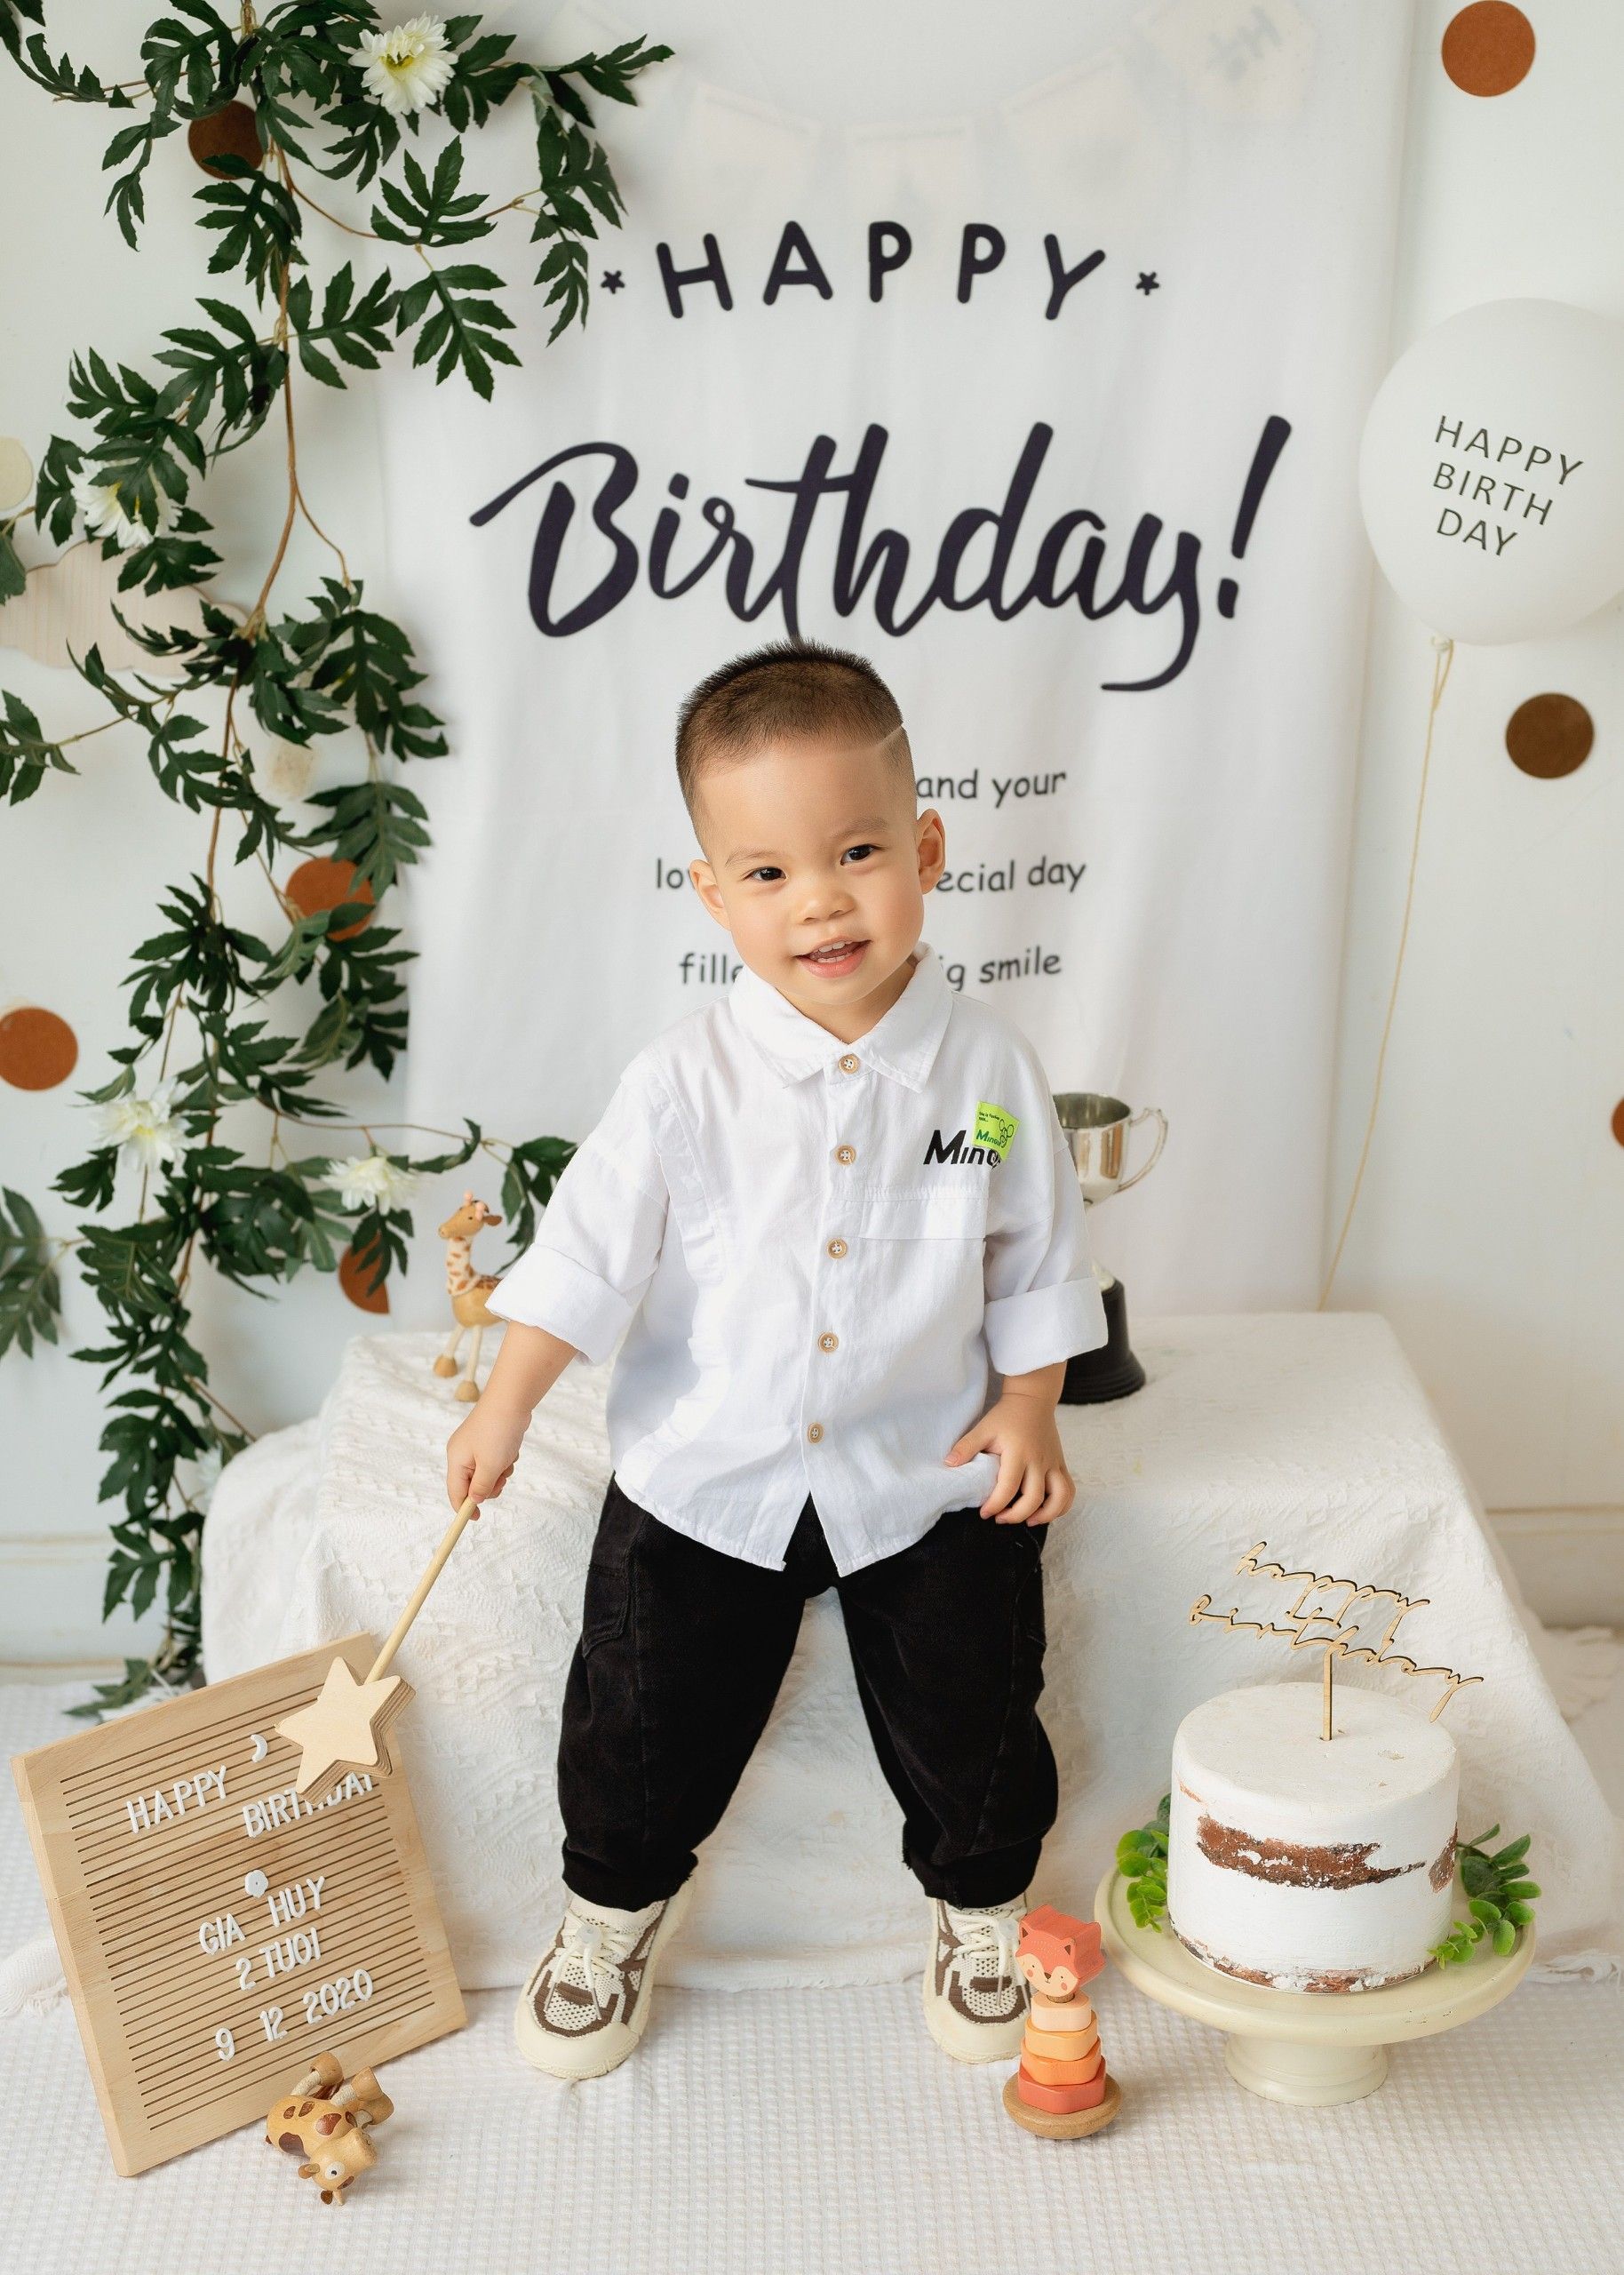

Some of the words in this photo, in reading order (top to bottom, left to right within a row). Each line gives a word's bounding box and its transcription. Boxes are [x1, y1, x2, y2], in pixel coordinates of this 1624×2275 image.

[656, 220, 1106, 321] HAPPY
[1435, 415, 1584, 486] HAPPY
[1433, 462, 1554, 526] BIRTH
[469, 414, 1292, 692] Birthday!
[1437, 507, 1517, 556] DAY
[917, 770, 978, 800] and
[992, 771, 1067, 809] your
[656, 858, 693, 890] lo
[935, 858, 1015, 893] ecial
[1028, 855, 1086, 893] day
[979, 946, 1062, 984] smile
[1235, 1540, 1430, 1637] happy
[1189, 1593, 1485, 1723] birthday
[126, 1764, 227, 1834] HAPPY
[198, 1912, 246, 1956] GIA
[267, 1875, 325, 1928] HUY
[235, 1957, 257, 1992] 2
[259, 1927, 322, 1979] TUOI
[215, 2027, 235, 2062] 9
[259, 2006, 289, 2042] 12
[302, 1968, 373, 2024] 2020
